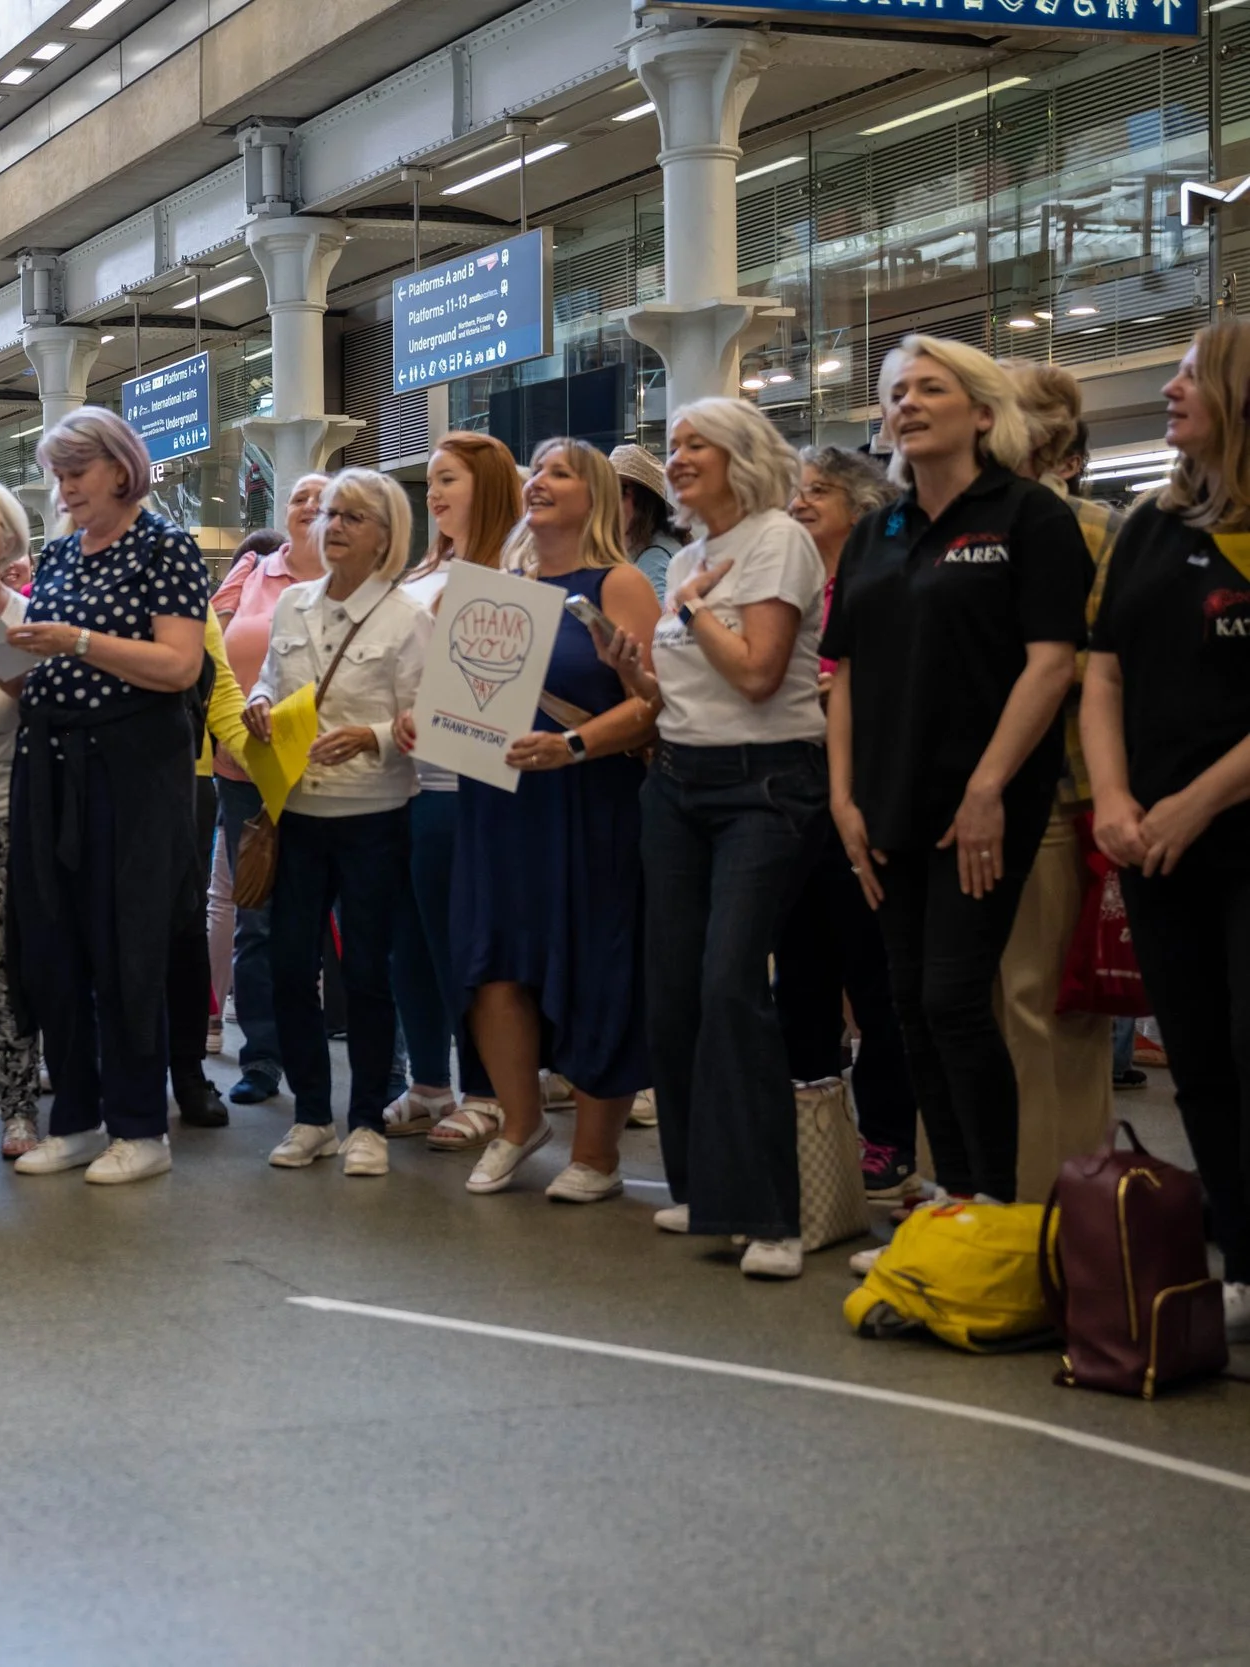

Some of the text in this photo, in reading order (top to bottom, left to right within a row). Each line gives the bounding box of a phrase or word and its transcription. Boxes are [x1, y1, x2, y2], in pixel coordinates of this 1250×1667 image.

[408, 262, 475, 298] Platforms A and B
[408, 293, 468, 326] Platforms 11-13
[408, 326, 457, 354] Underground
[458, 330, 466, 339] and
[465, 327, 479, 338] Victoria
[163, 368, 188, 386] Platforms
[188, 362, 197, 377] 1-4
[151, 390, 182, 412] International
[182, 387, 197, 402] trains
[165, 408, 198, 430] Underground
[943, 543, 1010, 564] KAREN
[458, 604, 527, 643] THANK
[459, 635, 517, 660] YOU
[472, 679, 495, 699] DAY
